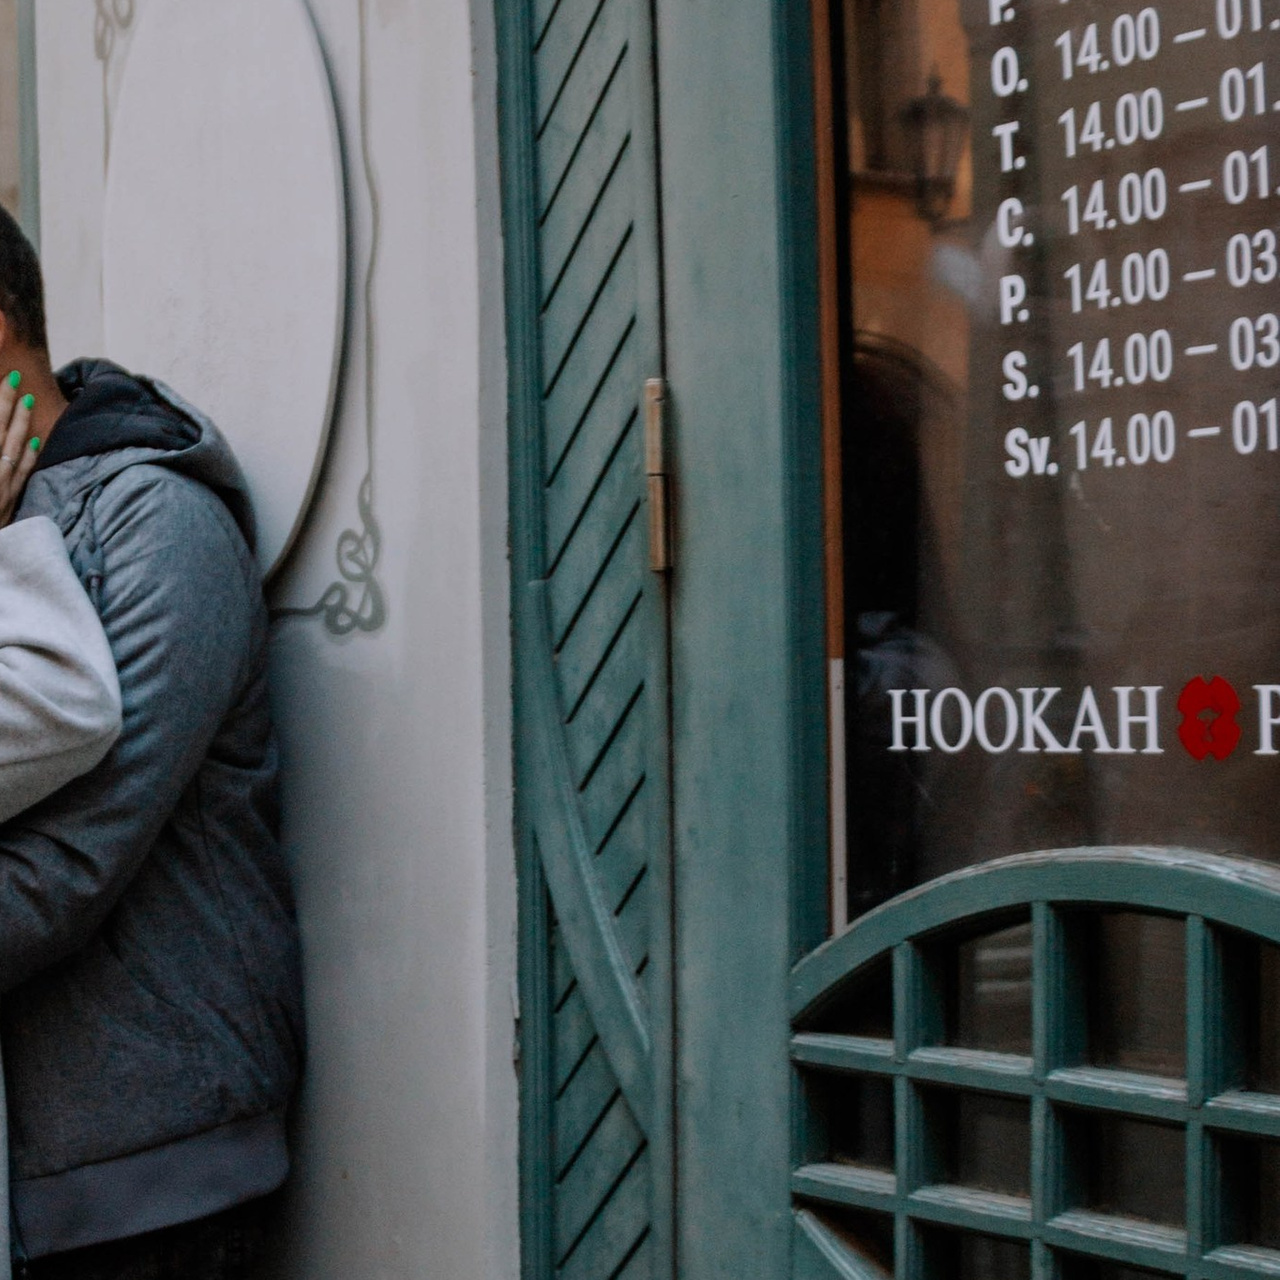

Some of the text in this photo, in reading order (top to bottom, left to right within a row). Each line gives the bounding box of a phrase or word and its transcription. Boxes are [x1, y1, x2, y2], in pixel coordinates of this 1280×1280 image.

[991, 46, 1028, 97] O.
[1054, 7, 1160, 81] 14.00
[992, 120, 1026, 172] T.
[1058, 87, 1164, 158] 14.00
[997, 197, 1034, 248] C.
[1061, 167, 1167, 235] 14.00
[1000, 274, 1029, 325] P.
[1064, 248, 1170, 313] 14.00
[1002, 350, 1039, 401] S.
[1067, 329, 1173, 392] 14.00
[1004, 427, 1059, 478] Sv.
[1070, 410, 1175, 471] 14.00
[886, 685, 1165, 754] HOOKAH
